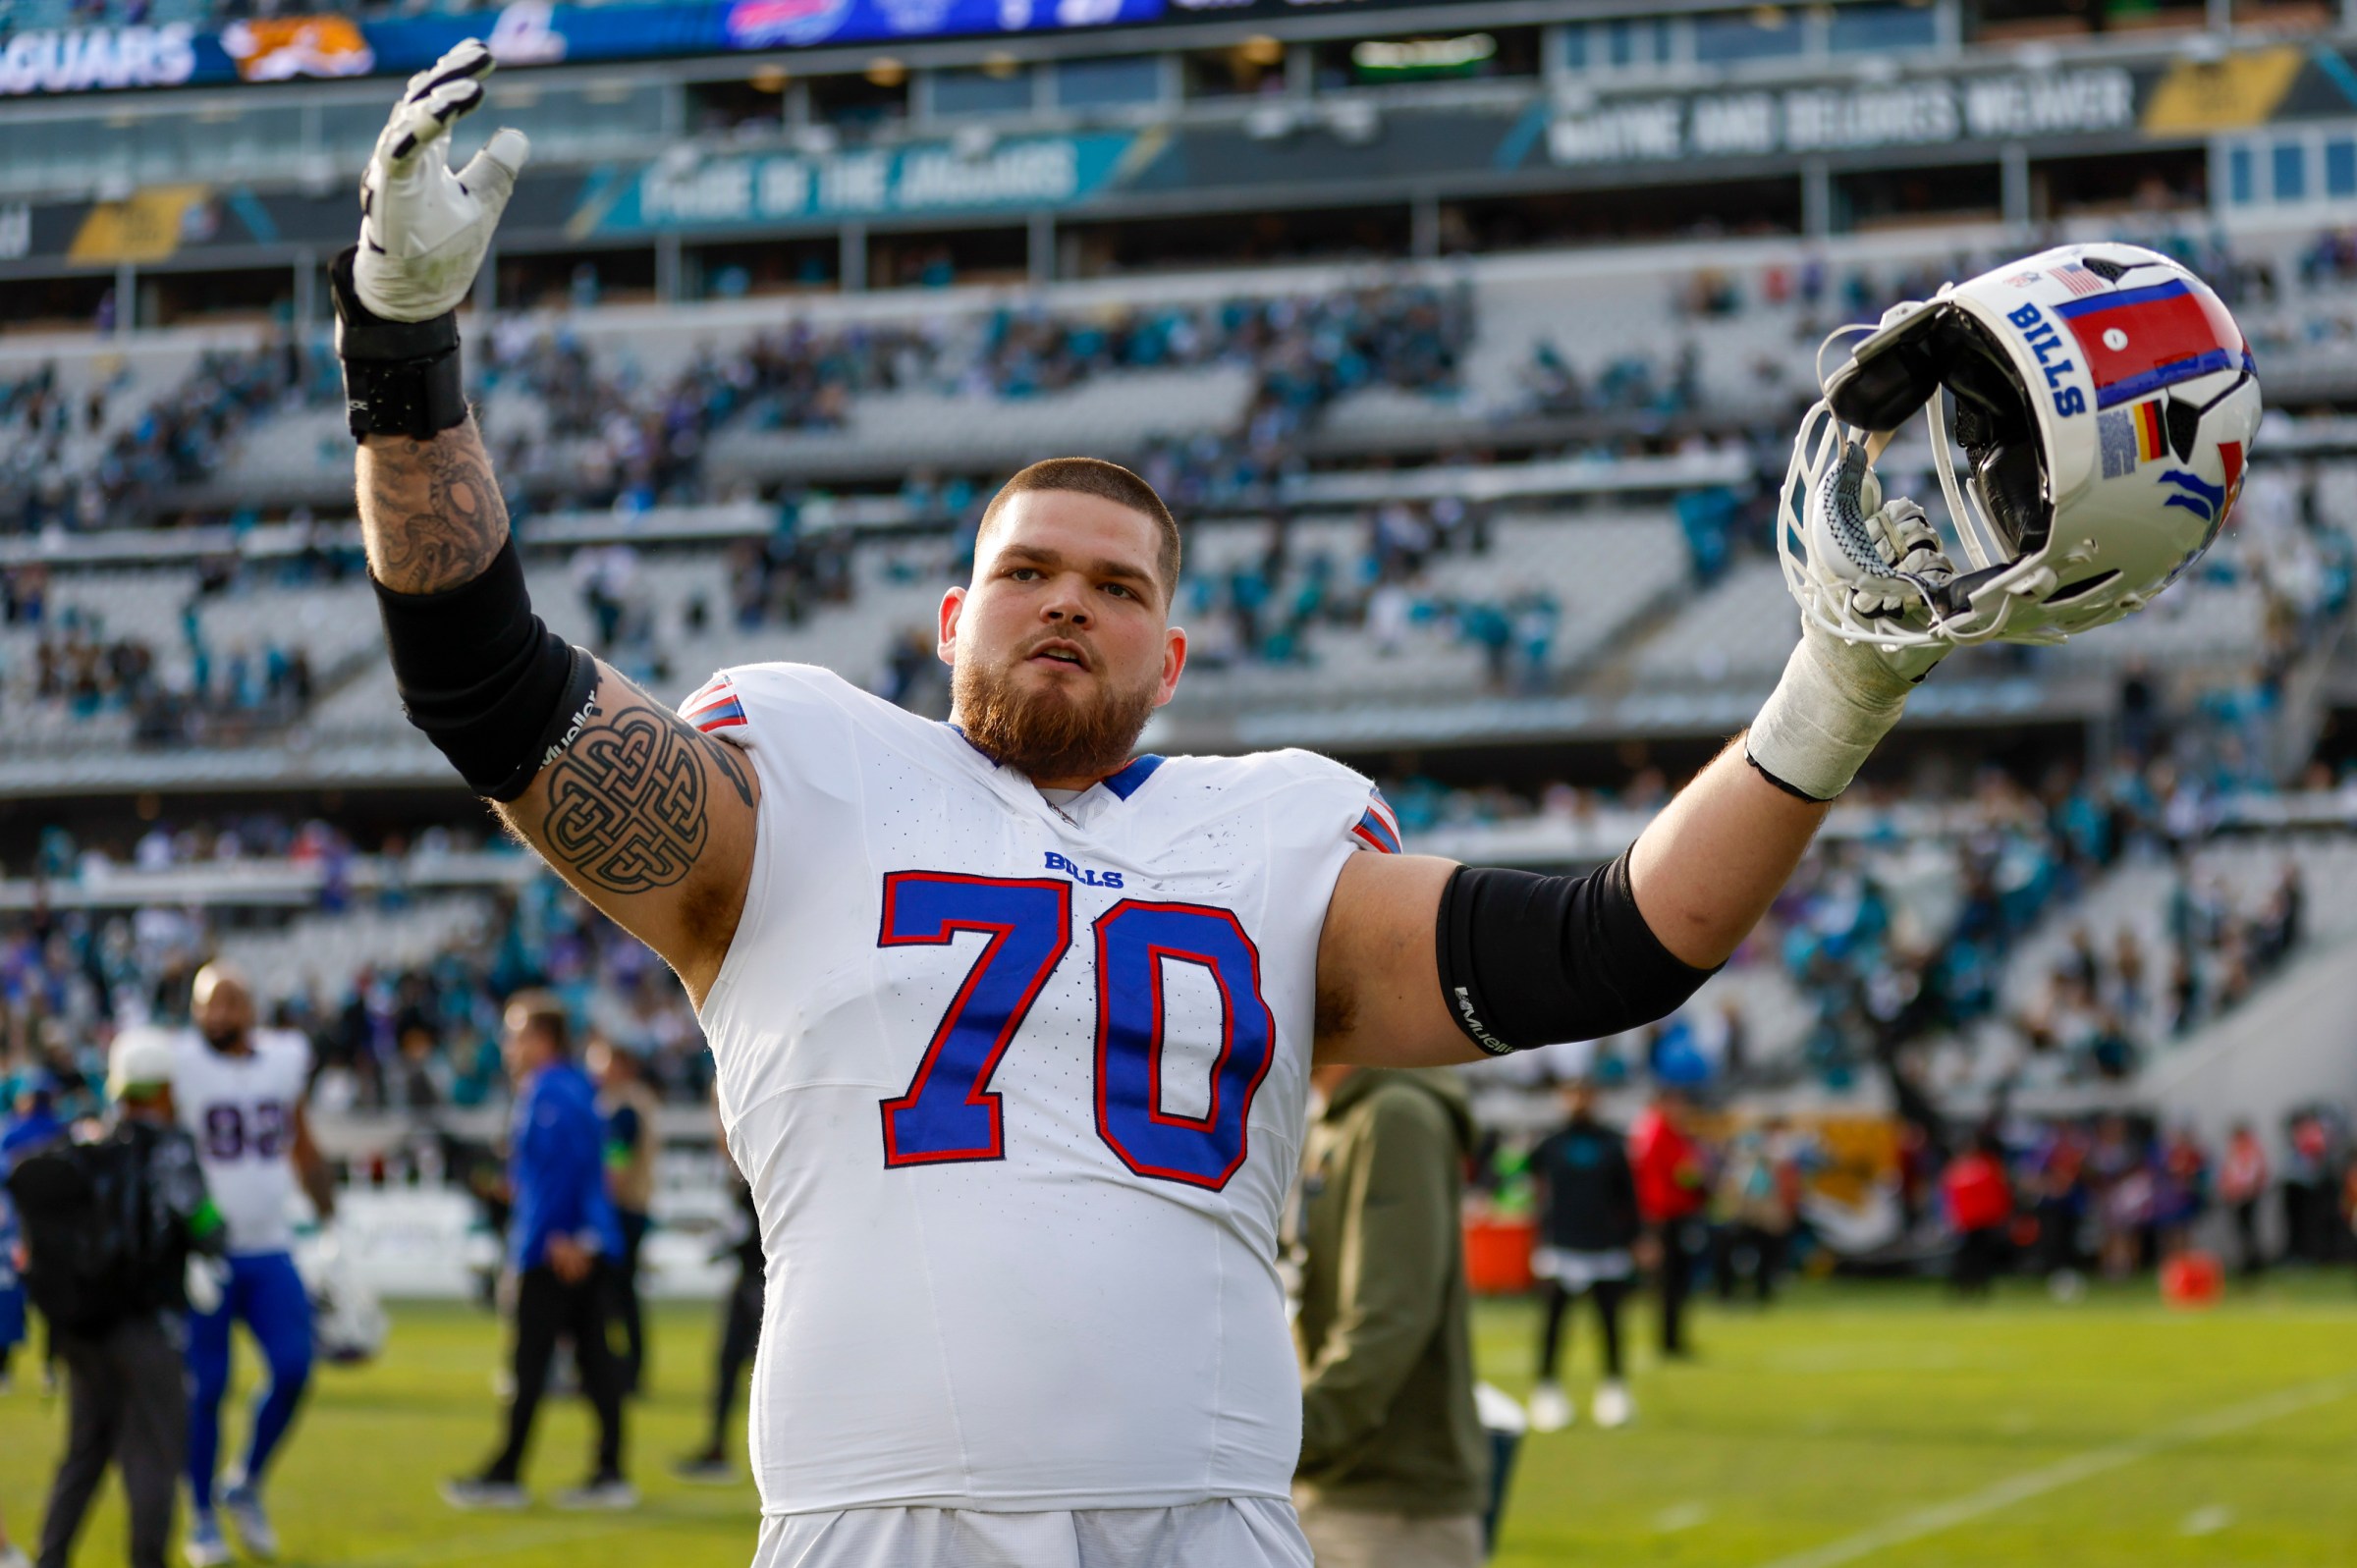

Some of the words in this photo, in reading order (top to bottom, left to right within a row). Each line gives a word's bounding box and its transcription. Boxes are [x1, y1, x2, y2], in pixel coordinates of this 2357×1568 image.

[0, 22, 196, 95] GUARS
[1968, 69, 2134, 138] WEAVER
[2006, 302, 2086, 418] BILLS
[1045, 851, 1124, 889] BILLS
[877, 870, 1276, 1192] 70
[1459, 1000, 1517, 1053] Muell
